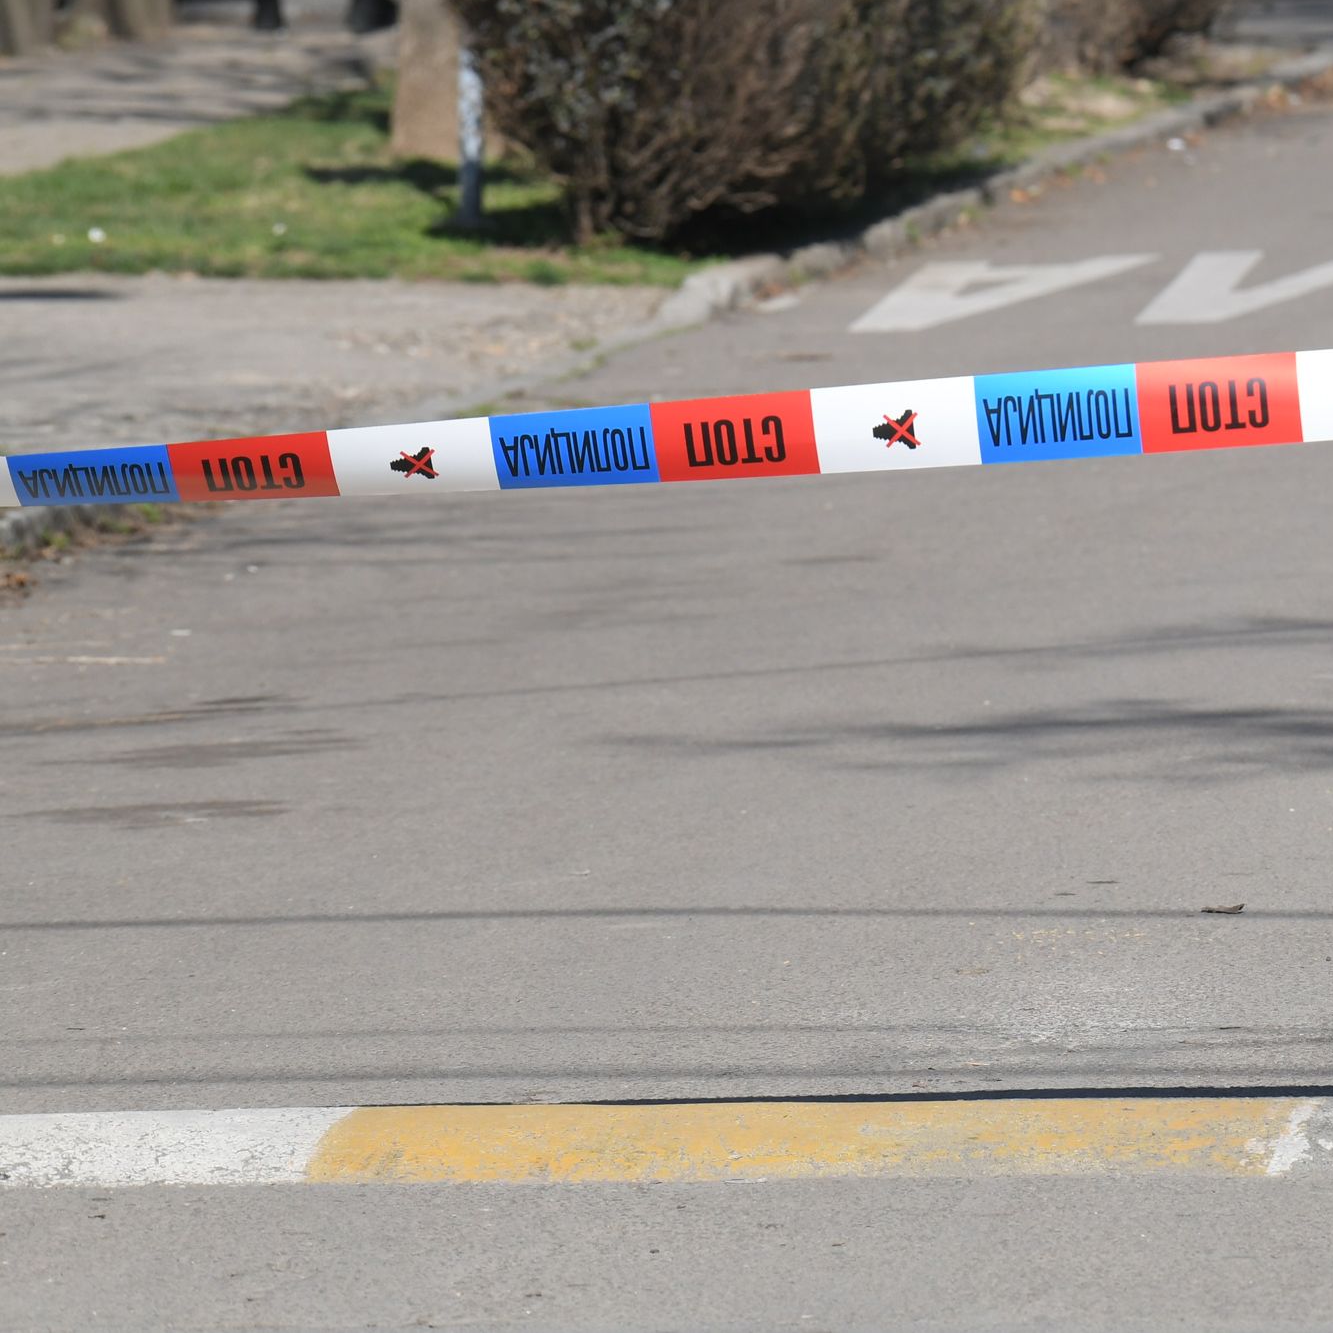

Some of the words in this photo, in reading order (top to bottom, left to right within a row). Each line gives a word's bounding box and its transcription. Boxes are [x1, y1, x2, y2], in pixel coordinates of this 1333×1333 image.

[983, 387, 1132, 448] ПОЛИЦИЈА
[1168, 377, 1270, 434] СТОП
[499, 426, 651, 477] ПОЛИЦИЈА
[685, 415, 787, 468] СТОП
[18, 461, 169, 499] ПОЛИЦИЈА
[201, 452, 305, 493] СТОП
